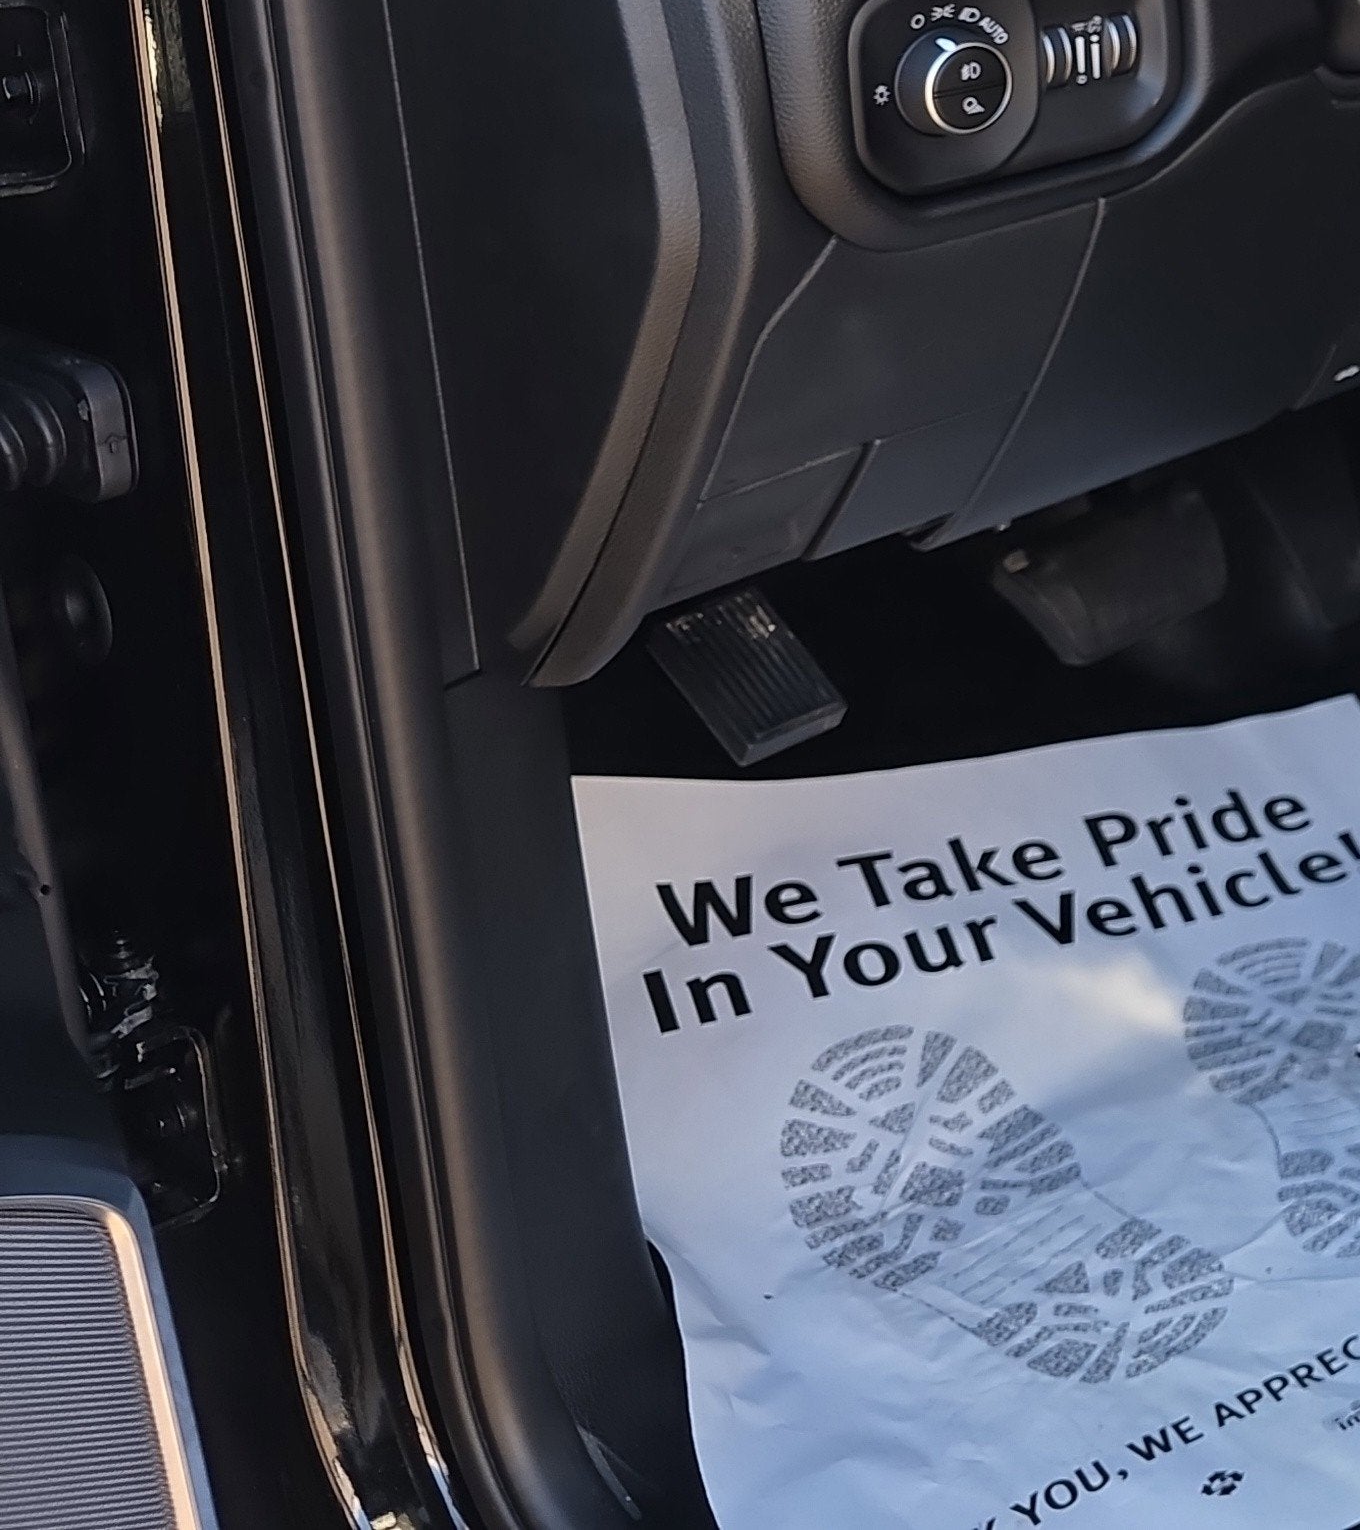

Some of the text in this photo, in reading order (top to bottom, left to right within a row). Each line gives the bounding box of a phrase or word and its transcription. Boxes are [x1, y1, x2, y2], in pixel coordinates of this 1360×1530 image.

[978, 16, 1010, 45] AUTO
[655, 788, 1313, 946] We Take Pride
[642, 969, 753, 1035] In
[767, 916, 998, 999] Your
[1009, 1460, 1129, 1526] YOU,
[1126, 1416, 1204, 1462] WE
